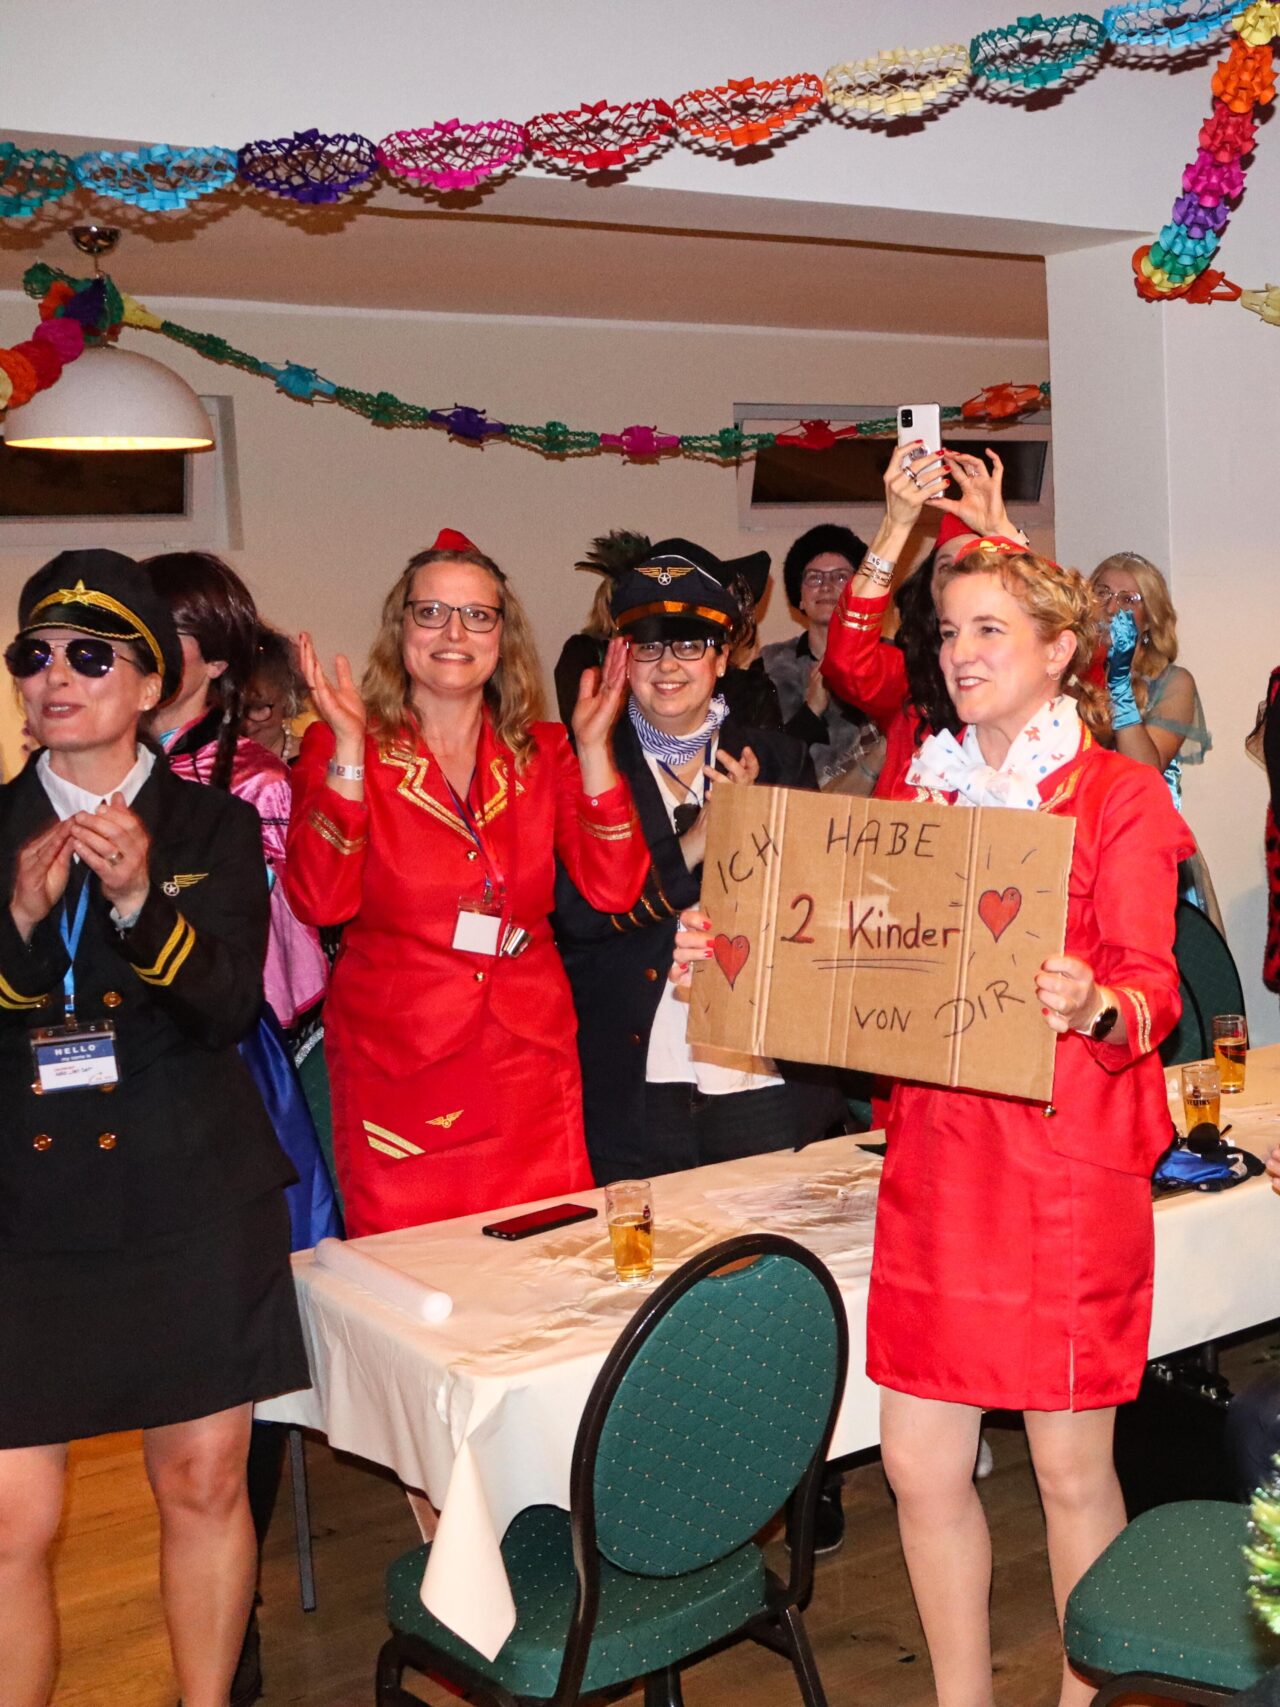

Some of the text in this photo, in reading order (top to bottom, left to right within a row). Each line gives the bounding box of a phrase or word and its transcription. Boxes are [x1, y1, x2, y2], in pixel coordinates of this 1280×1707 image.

[717, 816, 941, 894] ICH HABE
[780, 893, 961, 950] 2 Kinder
[854, 980, 1026, 1039] VON DIR
[55, 1044, 96, 1056] HELLO
